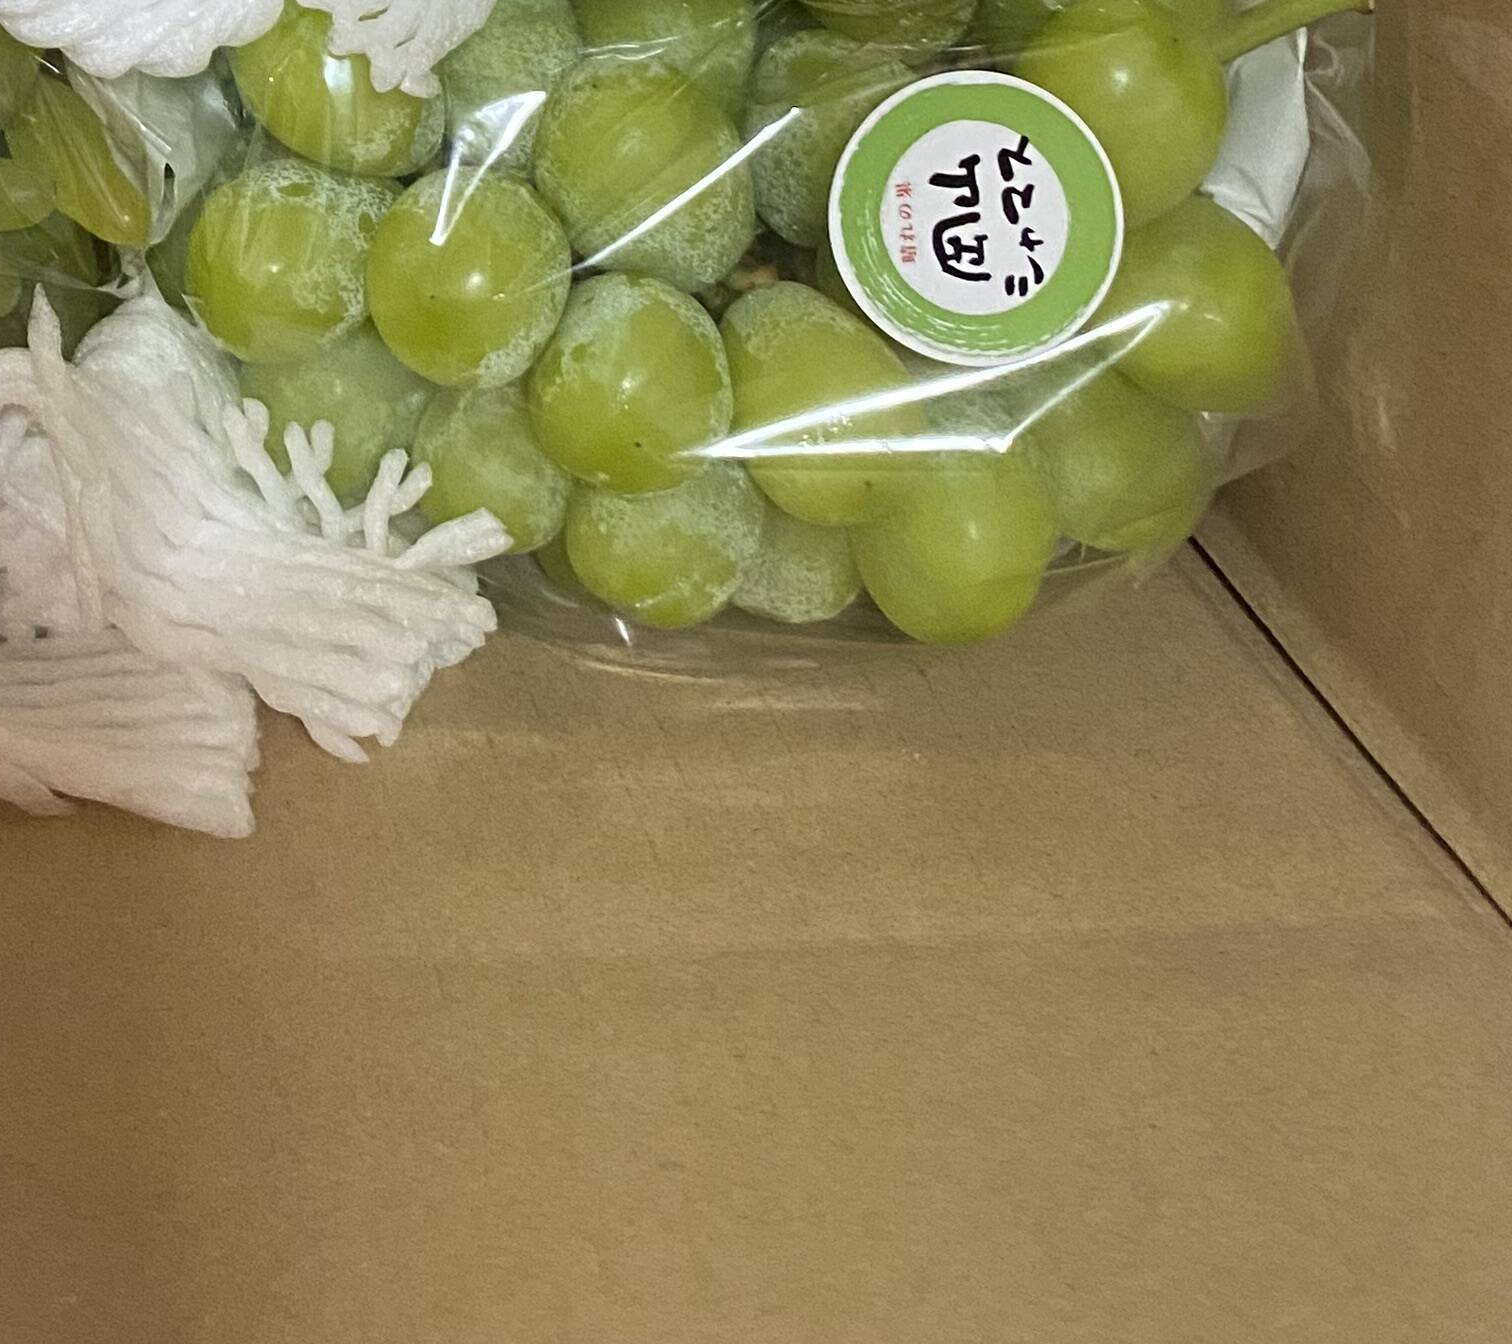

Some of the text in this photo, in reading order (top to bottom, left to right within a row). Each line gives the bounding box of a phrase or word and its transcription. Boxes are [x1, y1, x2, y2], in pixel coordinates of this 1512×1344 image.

[895, 180, 917, 265] 晴れの果
[928, 154, 992, 282] 岡山
[997, 134, 1044, 297] シャマス
